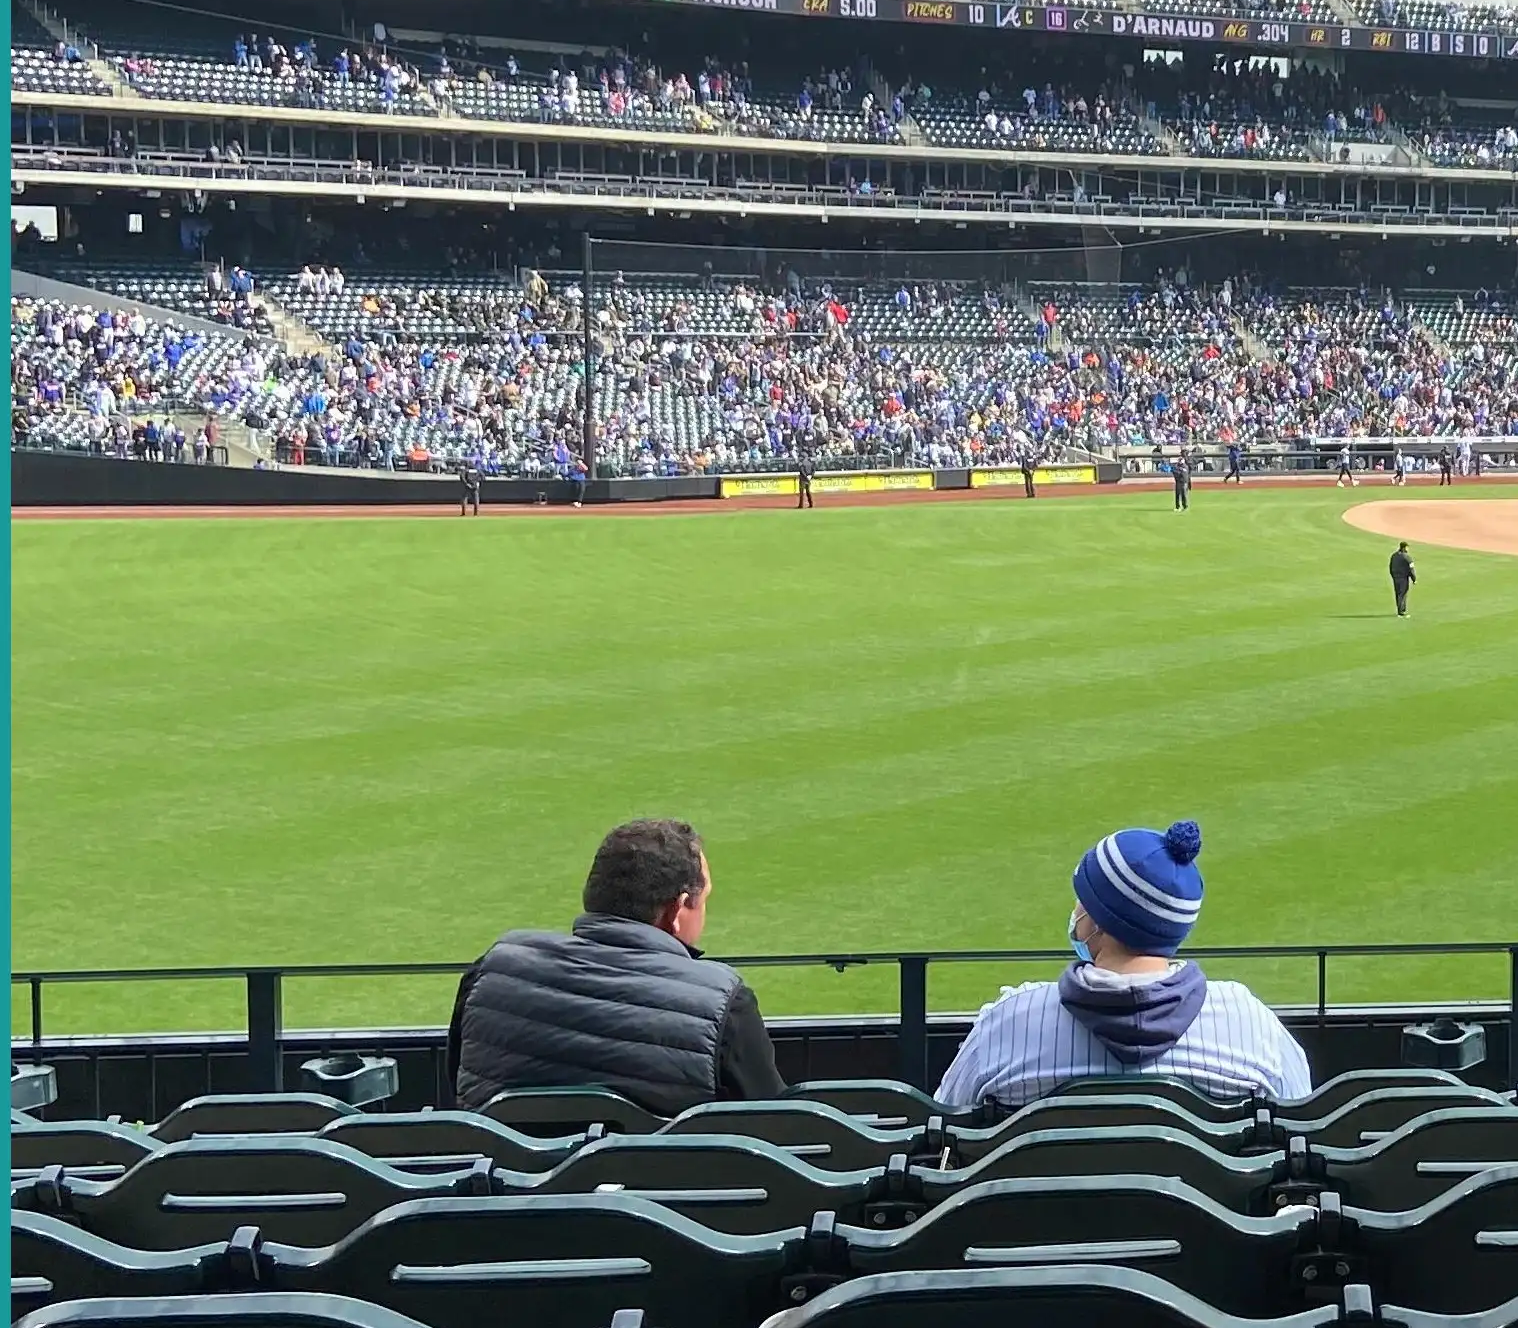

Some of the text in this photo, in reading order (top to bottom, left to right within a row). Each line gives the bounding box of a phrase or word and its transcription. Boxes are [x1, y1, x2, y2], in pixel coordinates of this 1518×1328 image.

[907, 2, 953, 19] PITCHES
[968, 5, 984, 23] 10
[1026, 10, 1034, 24] C
[1112, 15, 1215, 38] D'ARNAUD
[1257, 24, 1289, 42] .304
[1341, 28, 1351, 46] 2
[1373, 32, 1392, 47] RBI
[1405, 32, 1419, 50] 12
[1431, 34, 1440, 52] B
[1455, 35, 1464, 53] S
